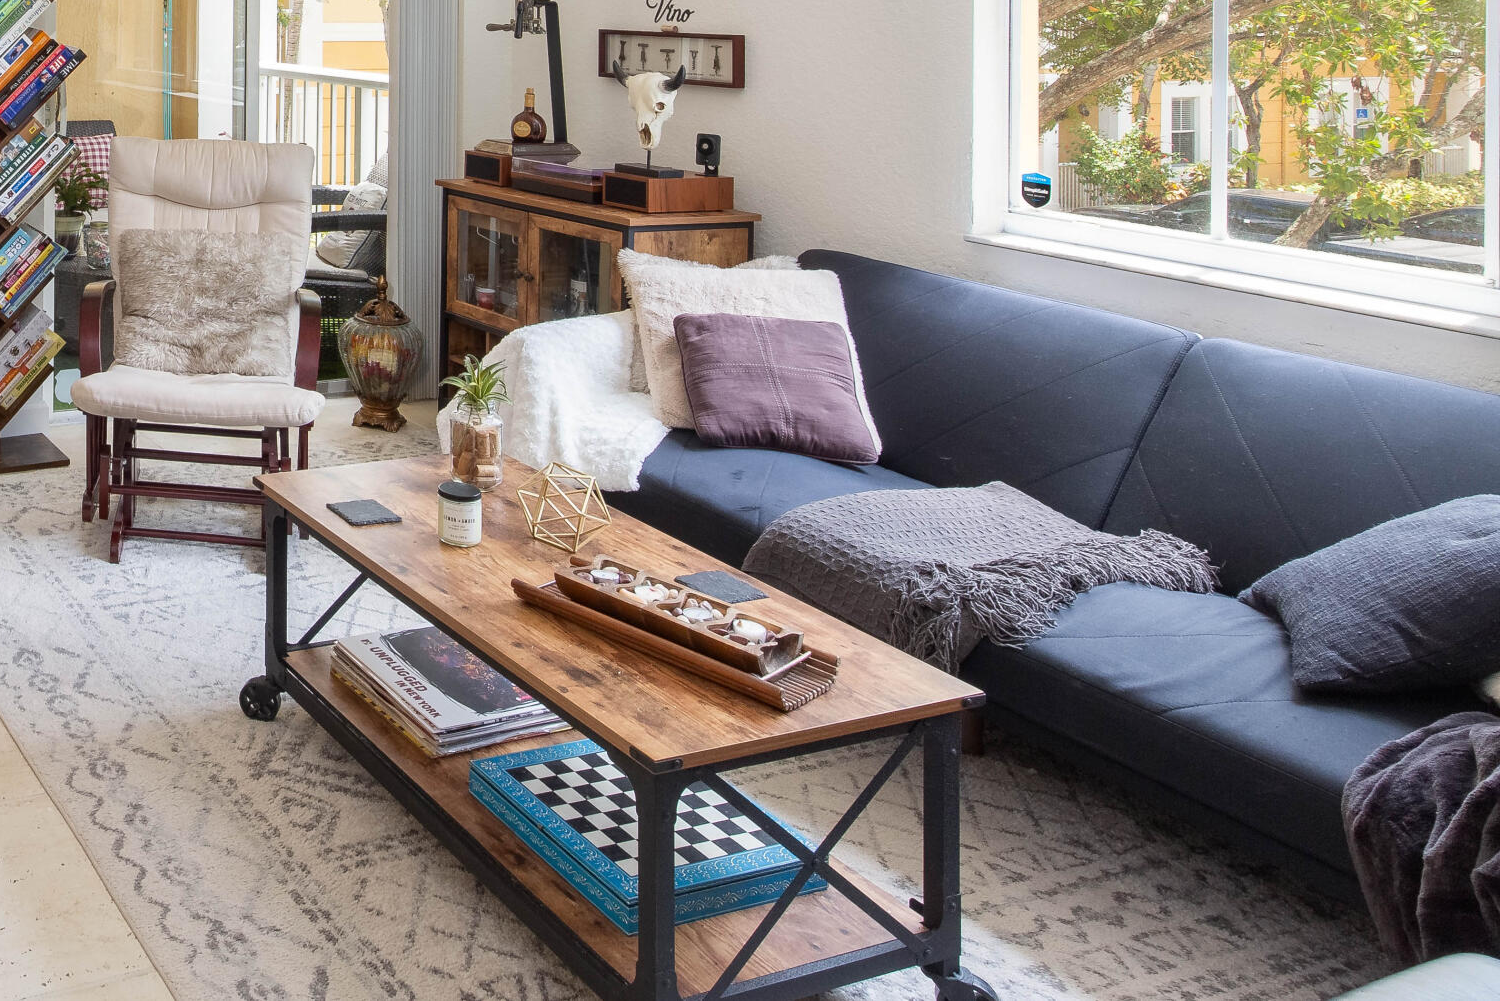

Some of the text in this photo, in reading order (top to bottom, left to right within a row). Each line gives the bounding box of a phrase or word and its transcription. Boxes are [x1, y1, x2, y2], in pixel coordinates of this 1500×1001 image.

[10, 22, 27, 39] FIRST
[35, 54, 44, 63] The
[48, 54, 66, 73] LIFE
[59, 56, 79, 77] TIME
[8, 81, 19, 91] War
[12, 143, 35, 167] EXTREME
[3, 234, 21, 255] PAINTING
[7, 237, 27, 259] ROCK
[15, 355, 47, 391] HOME PRESERVING
[369, 646, 428, 692] UNPLUGGED
[394, 680, 443, 719] IN NEW YORK
